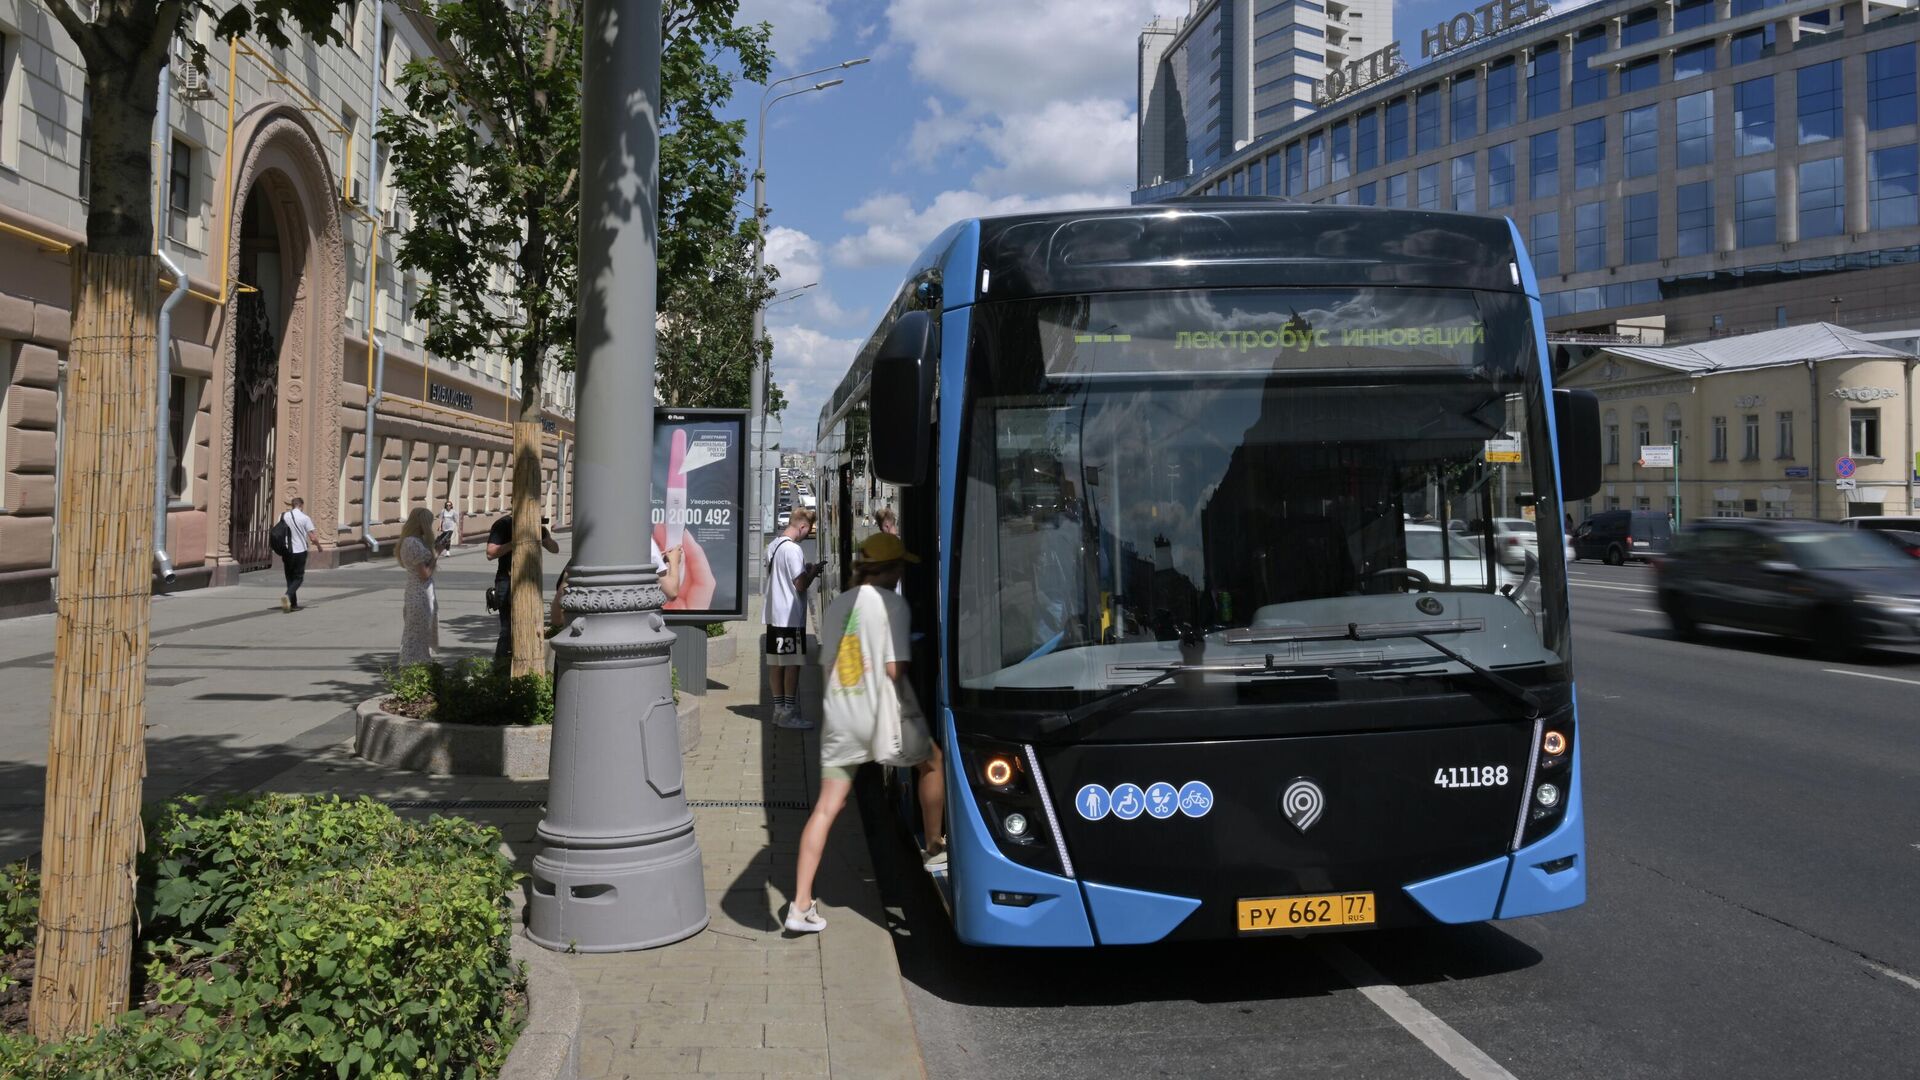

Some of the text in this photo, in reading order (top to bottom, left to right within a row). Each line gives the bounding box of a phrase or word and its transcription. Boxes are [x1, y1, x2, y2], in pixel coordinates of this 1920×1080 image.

[1311, 0, 1549, 104] LOTTE HOTEL
[1173, 320, 1485, 353] лектробус инноваций
[431, 383, 474, 410] БИБЛИОТЕКА
[690, 498, 731, 506] Уверенность
[704, 508, 731, 525] 492
[775, 637, 796, 654] 23
[1434, 765, 1509, 788] 411188
[1288, 899, 1332, 924] 662
[1344, 896, 1367, 915] 77
[1348, 914, 1365, 922] RUS
